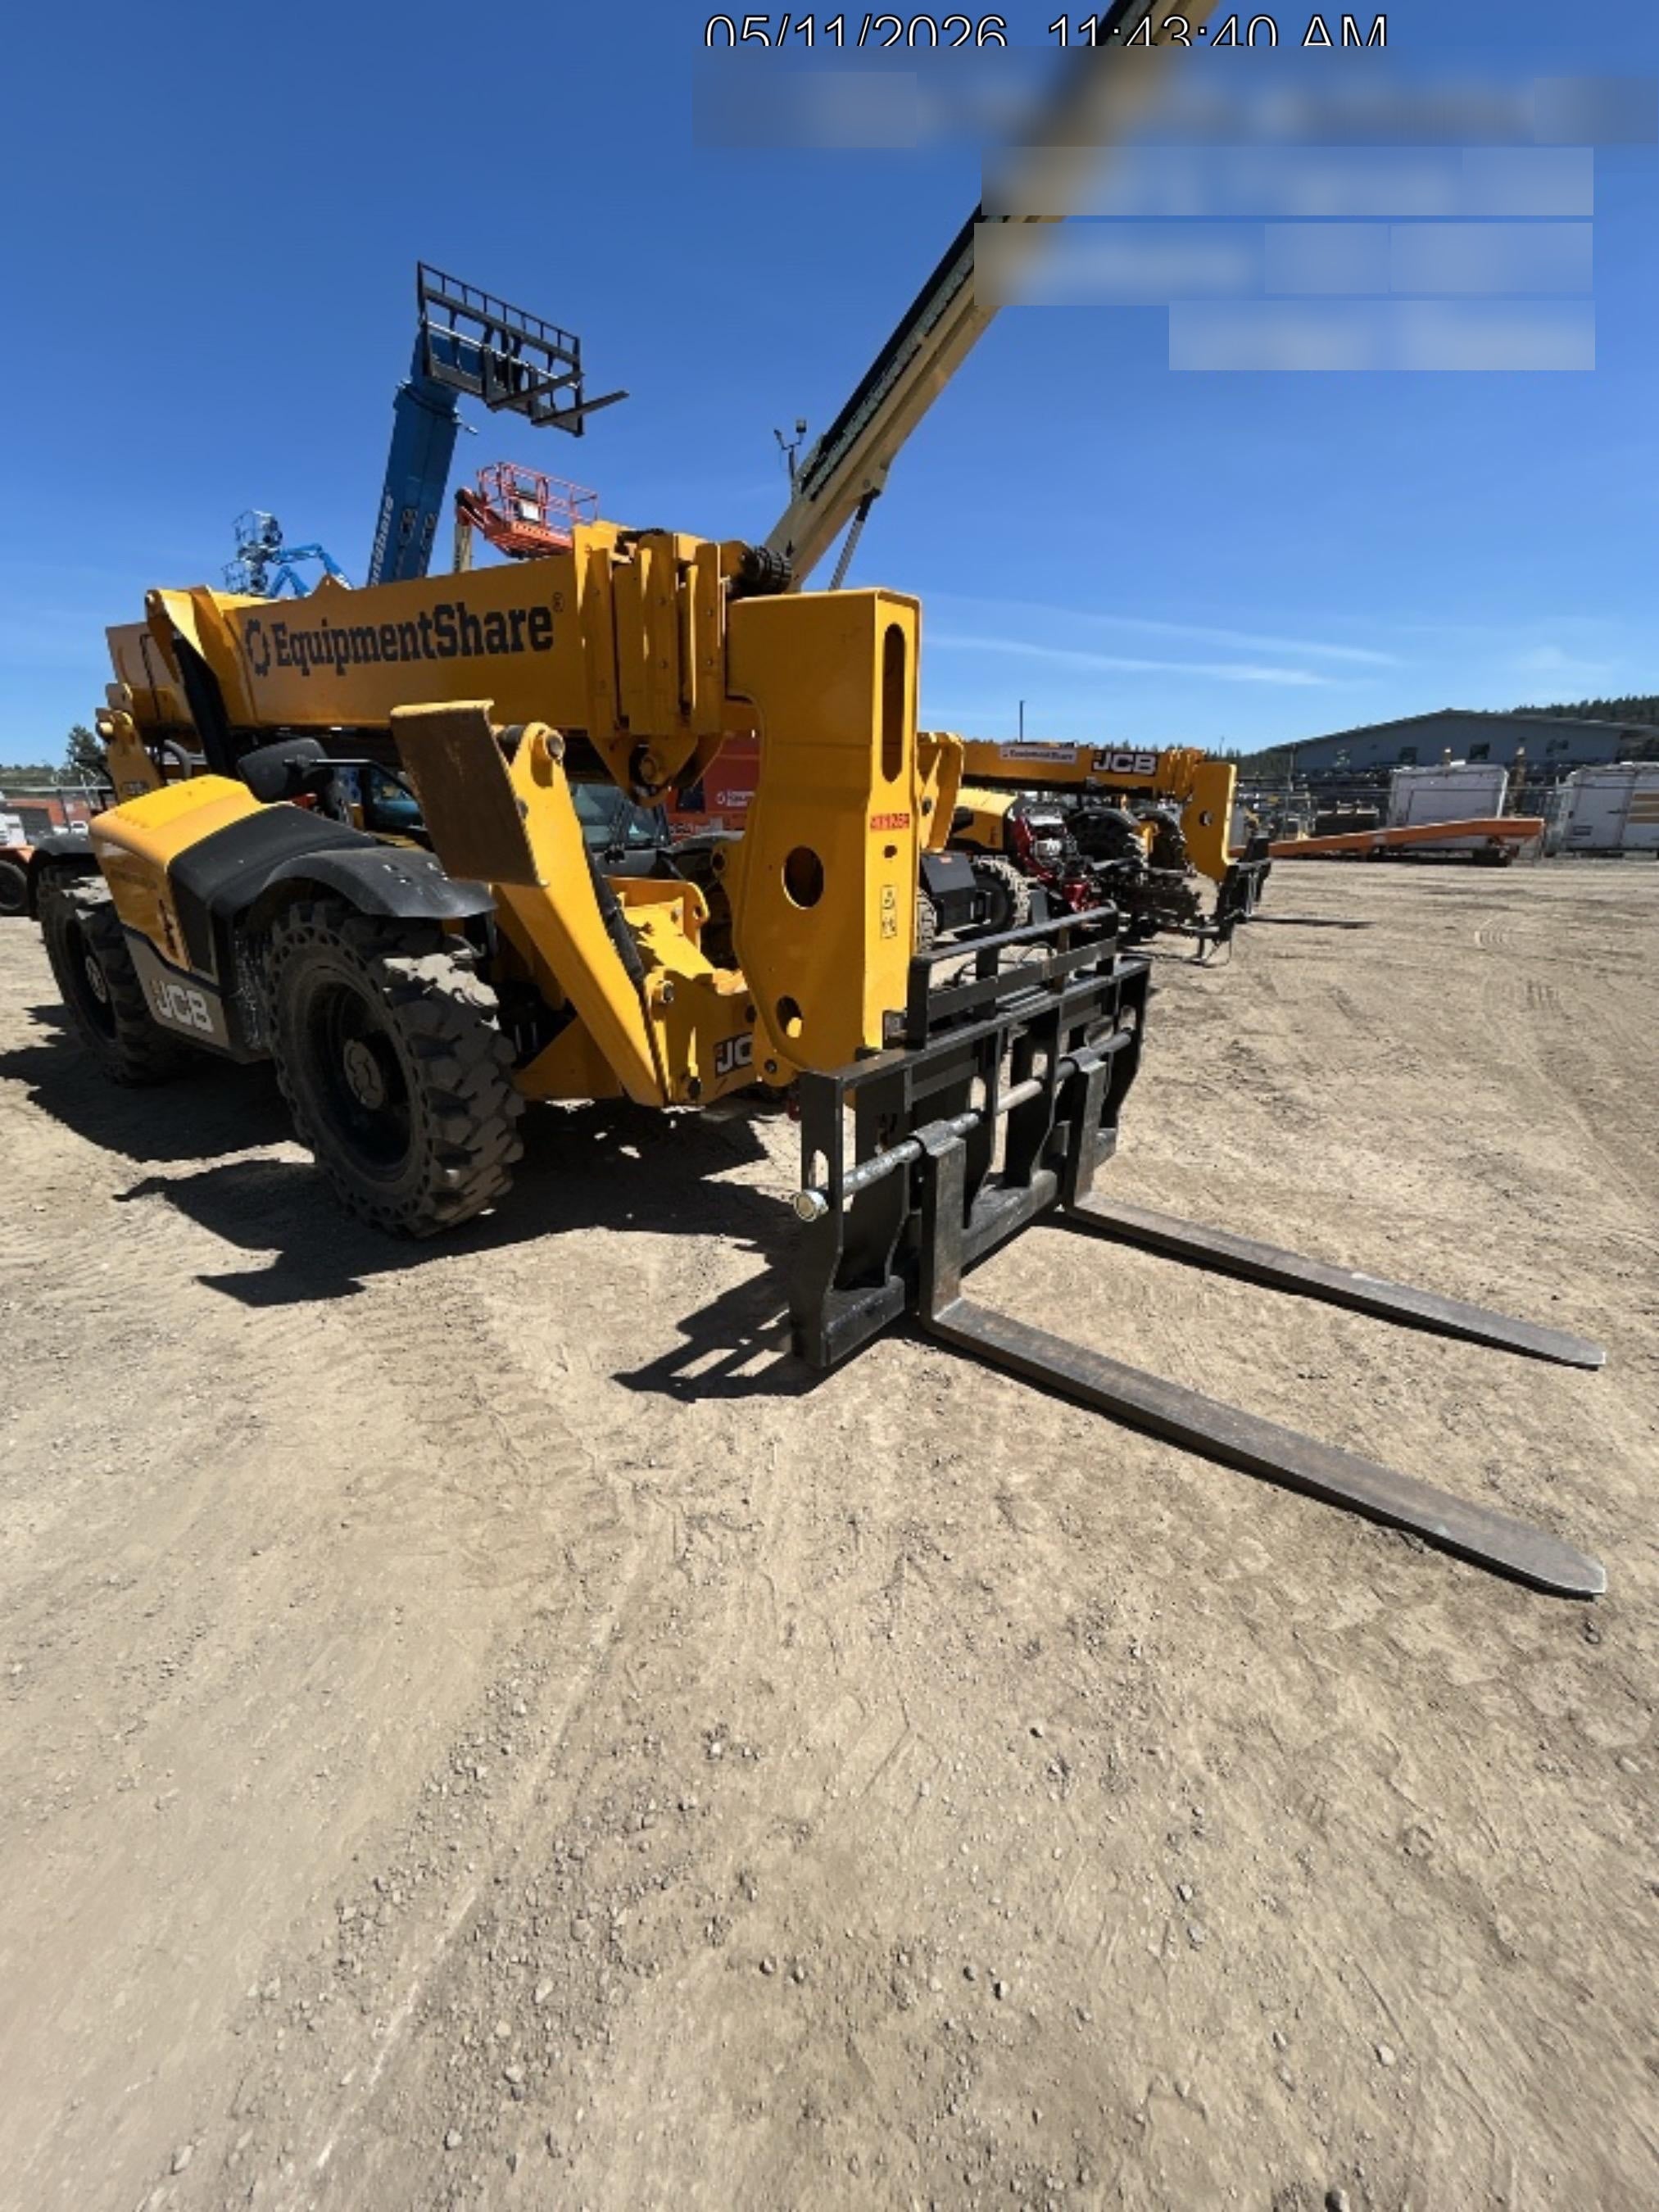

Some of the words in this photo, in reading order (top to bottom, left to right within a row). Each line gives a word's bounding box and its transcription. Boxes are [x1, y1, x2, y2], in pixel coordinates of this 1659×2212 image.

[270, 602, 553, 676] EquipmentShare
[1093, 751, 1156, 775] JCB
[156, 983, 214, 1032] JCB
[717, 1034, 753, 1073] JC
